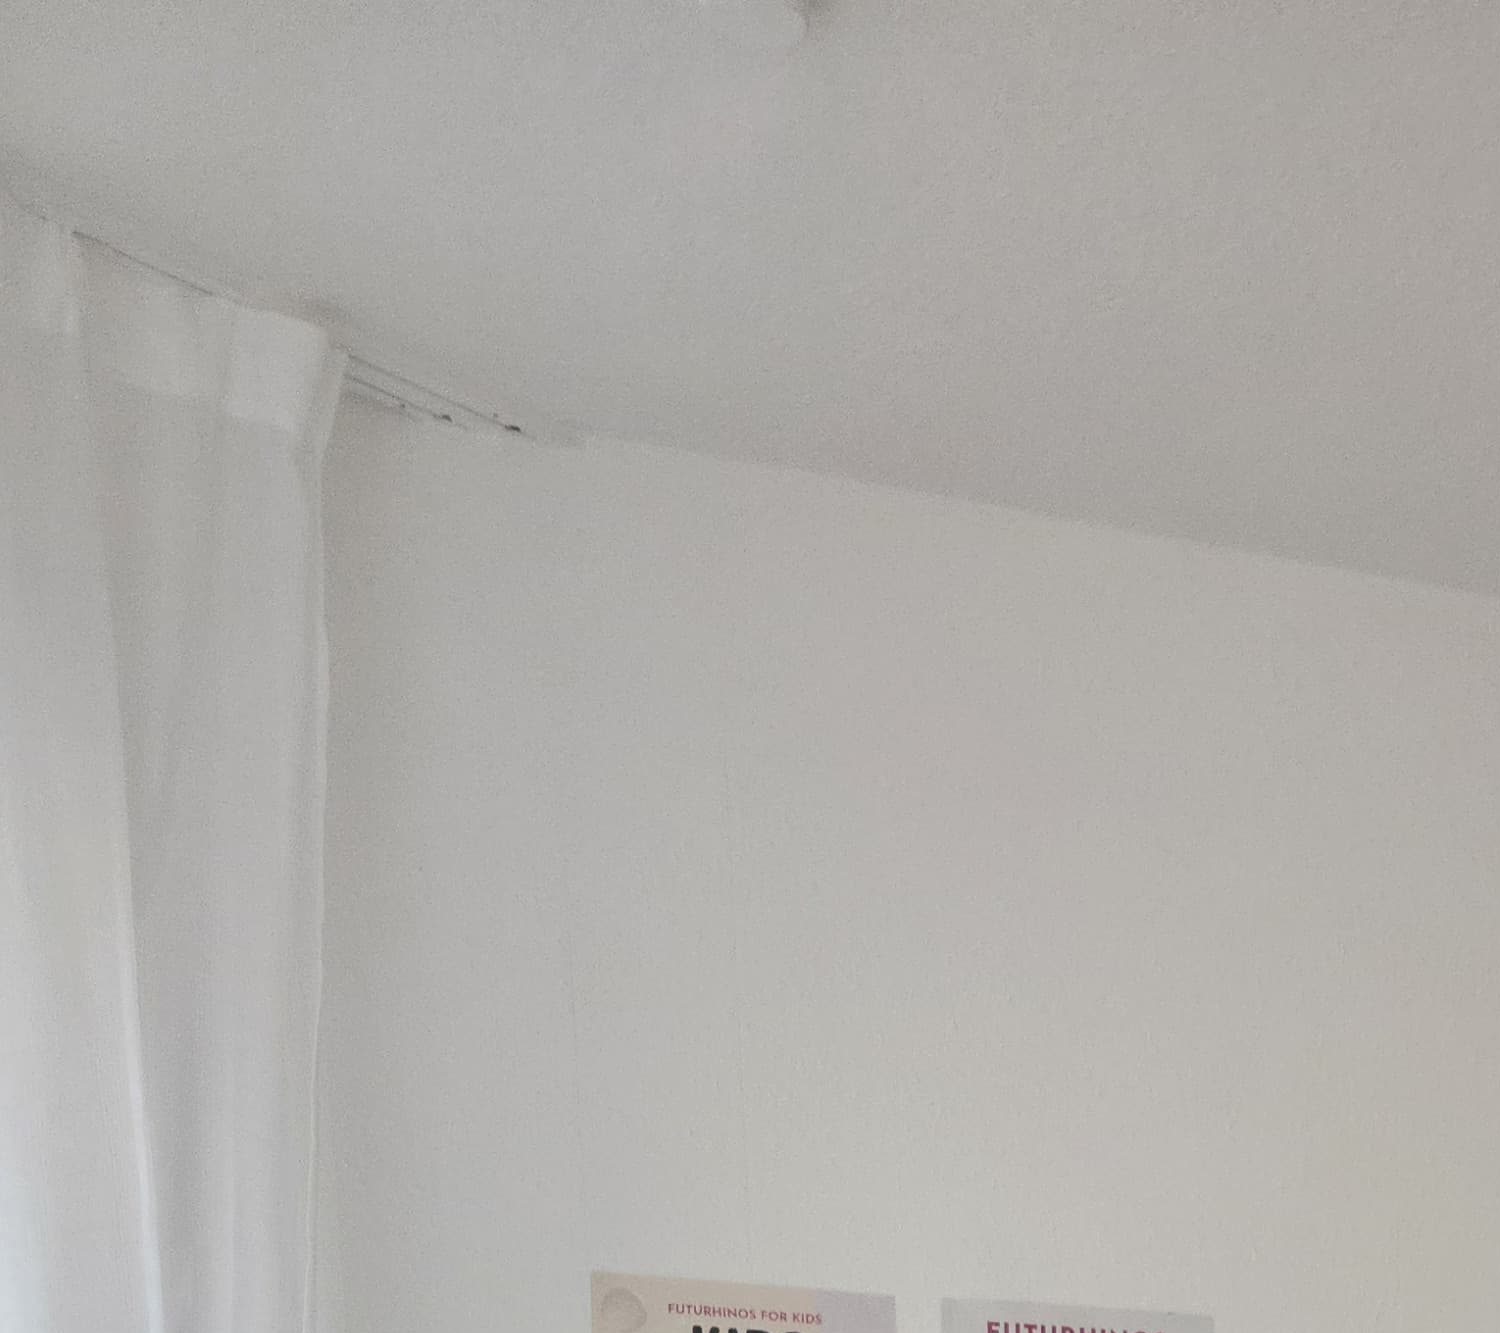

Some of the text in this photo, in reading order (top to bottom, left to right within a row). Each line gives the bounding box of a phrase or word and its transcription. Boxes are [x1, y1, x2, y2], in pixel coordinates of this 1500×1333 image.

[668, 1303, 822, 1325] FUTURHINOS FOR KIDS
